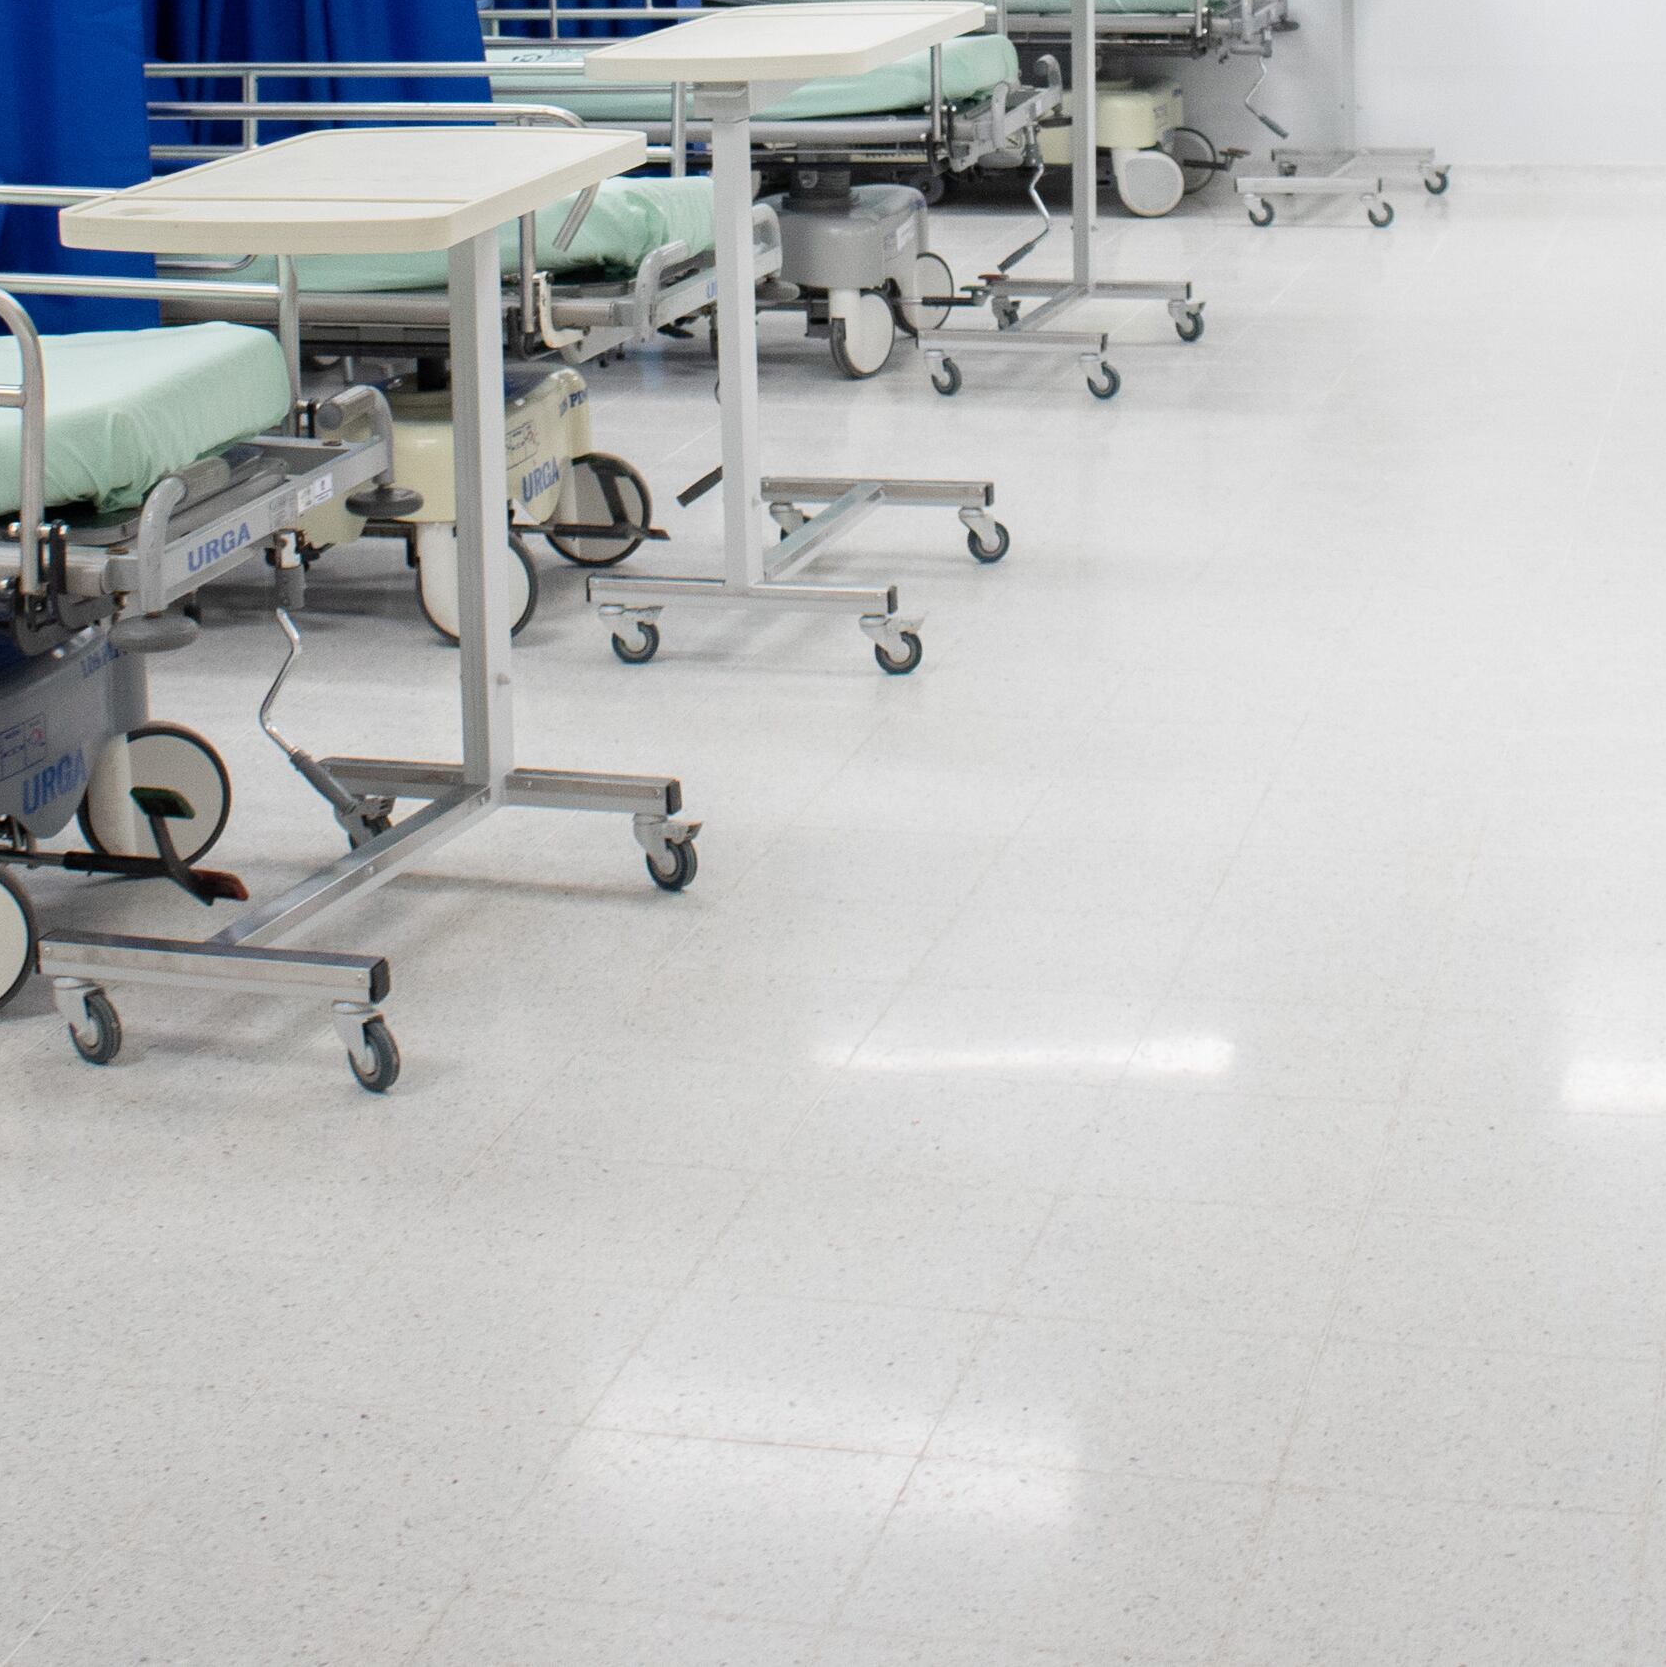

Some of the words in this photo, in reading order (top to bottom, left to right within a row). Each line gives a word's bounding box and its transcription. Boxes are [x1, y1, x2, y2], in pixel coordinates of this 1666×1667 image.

[521, 454, 560, 503] URGA
[187, 521, 252, 573] URGA
[22, 748, 88, 816] URGA
